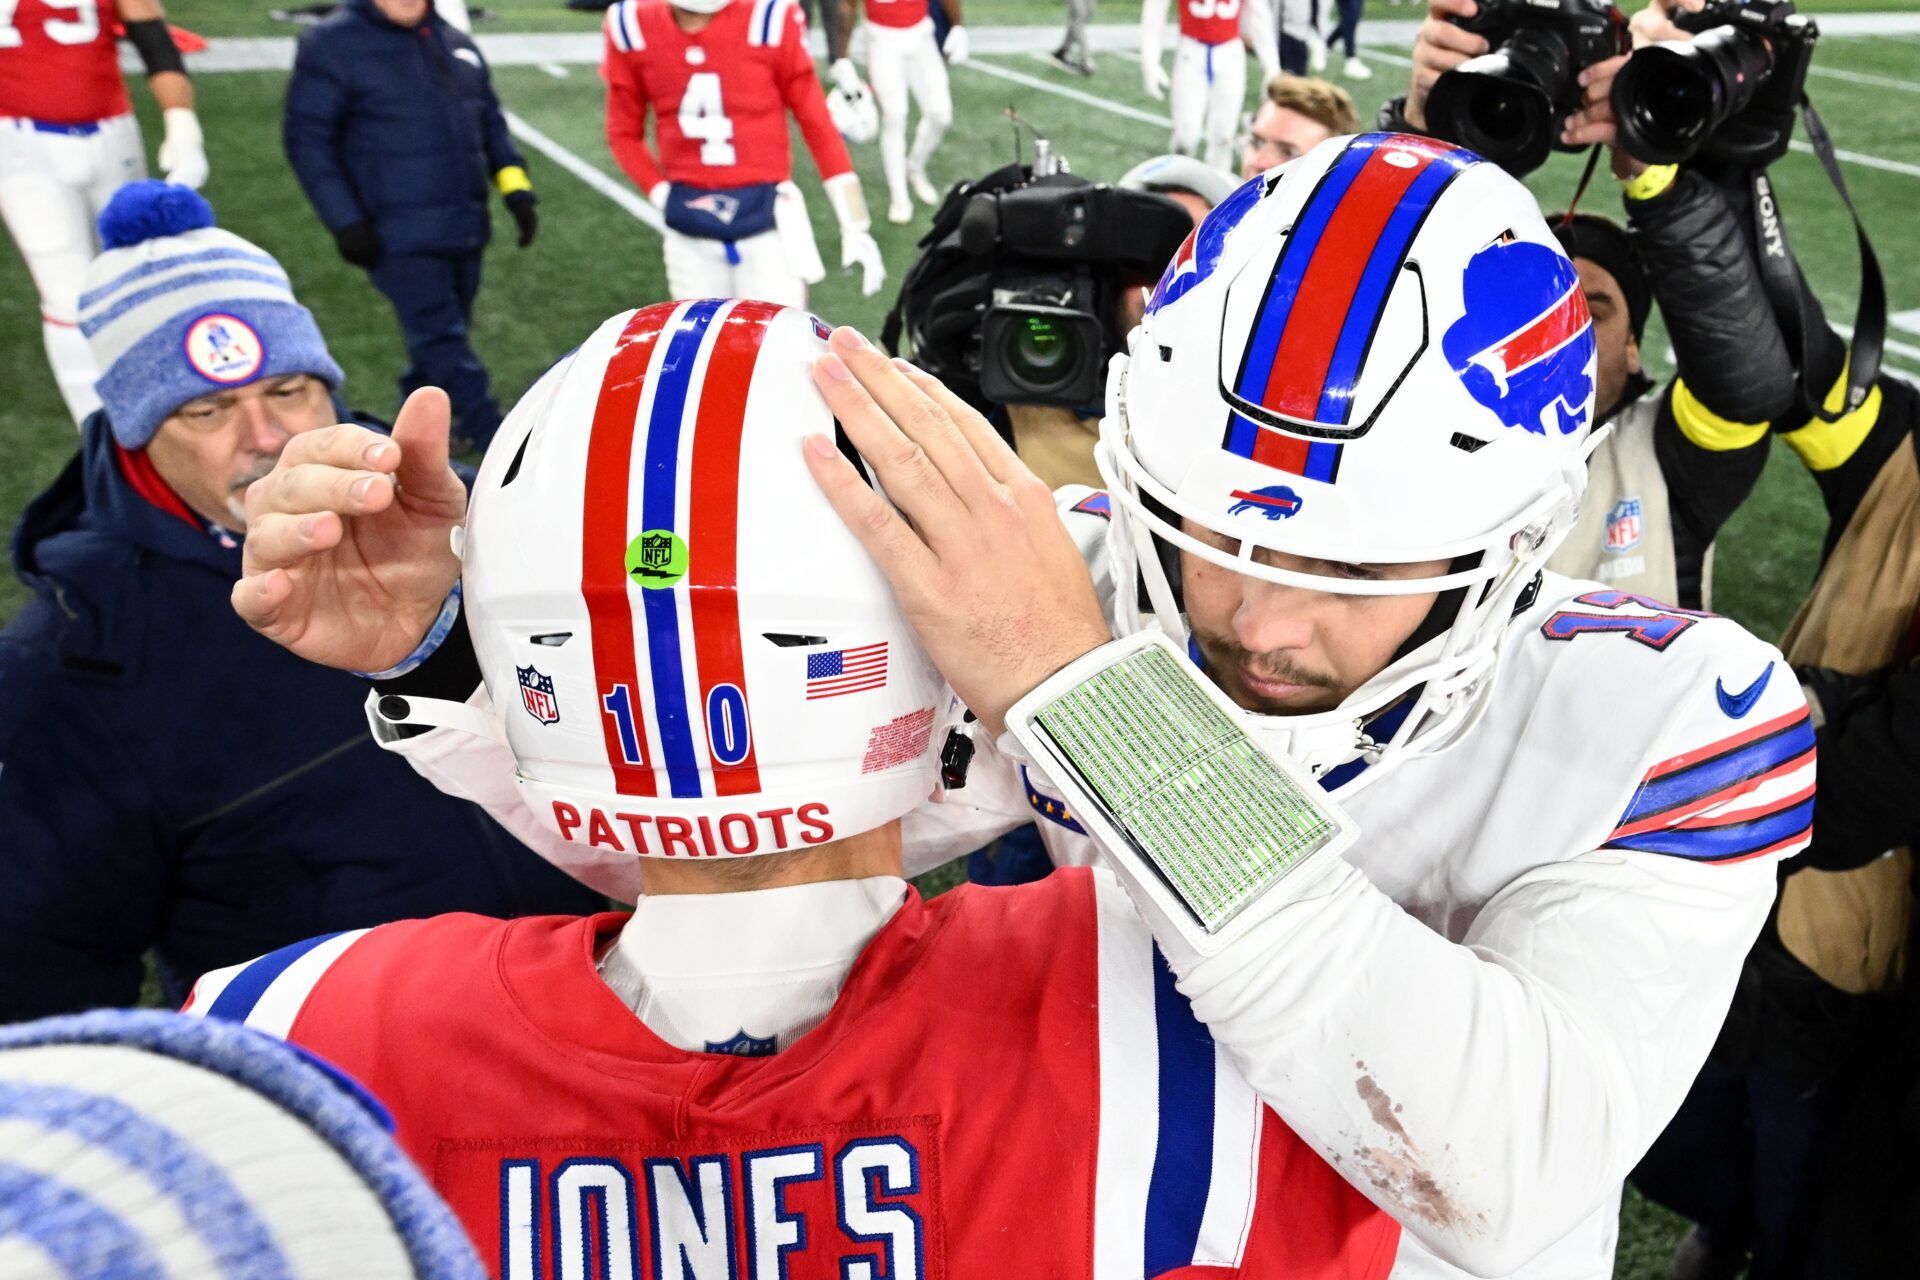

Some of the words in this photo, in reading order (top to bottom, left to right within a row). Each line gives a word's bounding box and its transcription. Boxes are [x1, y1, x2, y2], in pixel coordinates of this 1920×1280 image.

[678, 72, 737, 166] 4
[1756, 176, 1785, 258] SONY
[644, 548, 670, 565] NFL
[523, 687, 557, 720] NFL
[551, 799, 835, 858] PATRIOTS
